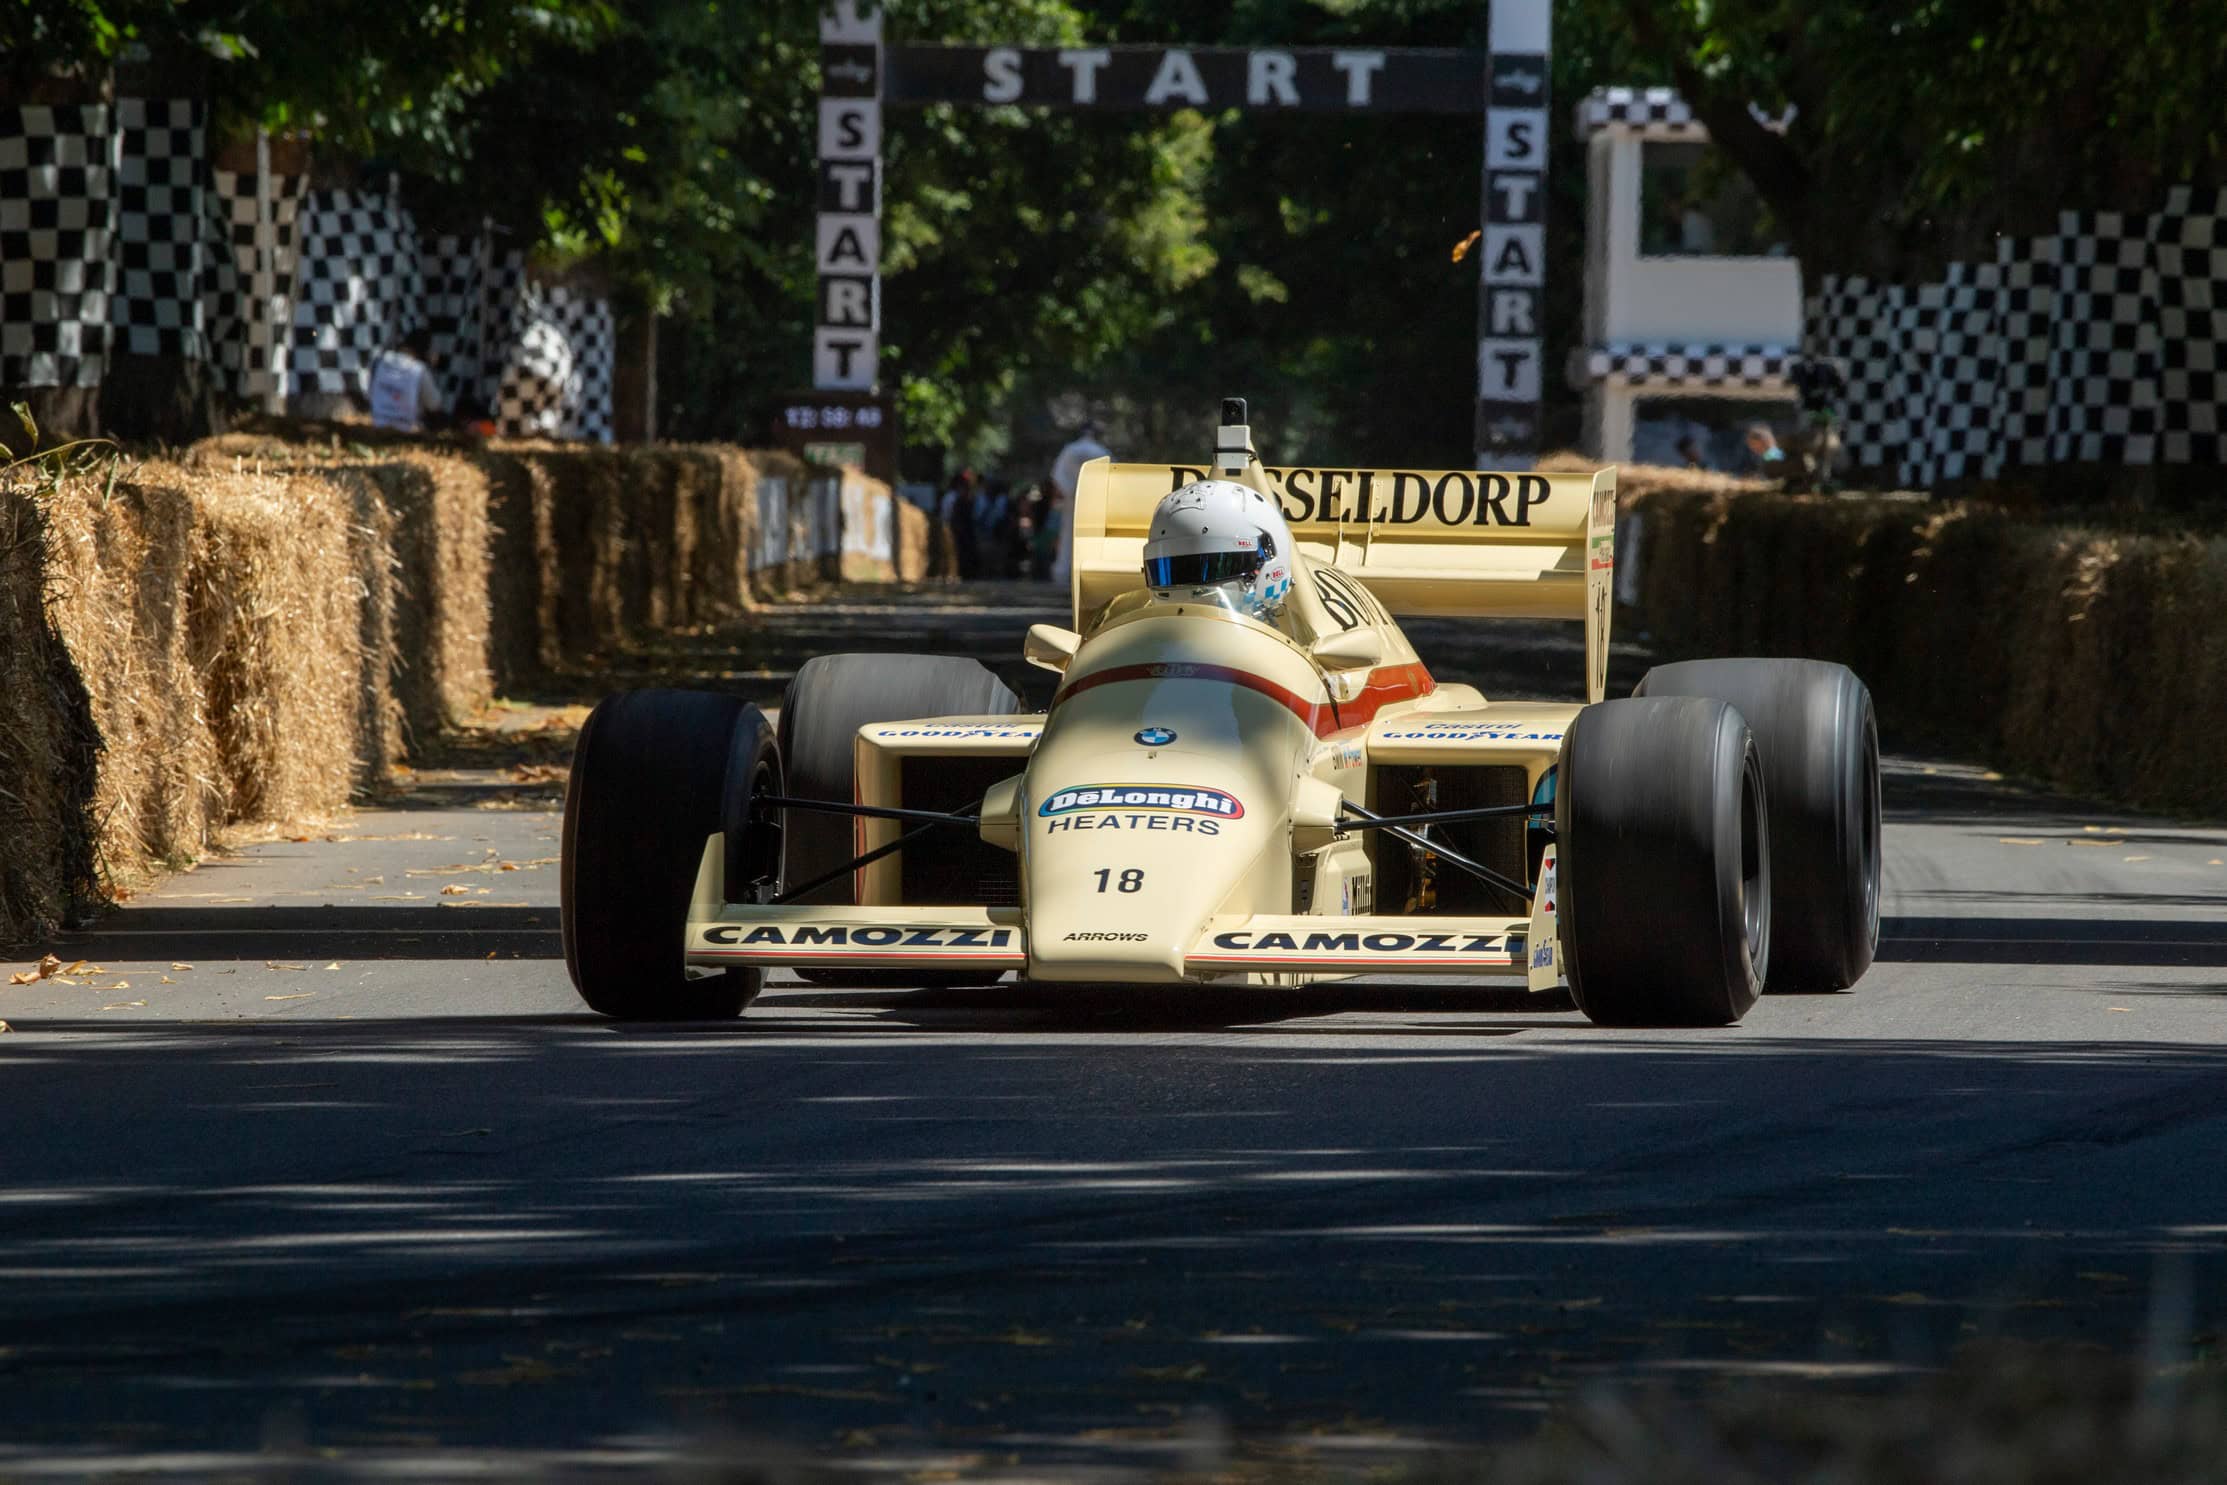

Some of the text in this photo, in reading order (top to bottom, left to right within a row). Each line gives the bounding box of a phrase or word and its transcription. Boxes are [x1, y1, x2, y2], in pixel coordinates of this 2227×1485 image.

[983, 50, 1385, 105] START
[827, 112, 870, 380] START
[1493, 121, 1537, 390] START
[1170, 466, 1551, 526] DSELDORP
[1382, 730, 1565, 741] GOODYEAR
[1047, 814, 1221, 836] HEATERS
[1093, 868, 1145, 893] 18
[702, 926, 1012, 947] CAMOZZI
[1063, 932, 1149, 942] ARROWS
[1213, 932, 1526, 953] CAMOZZI
